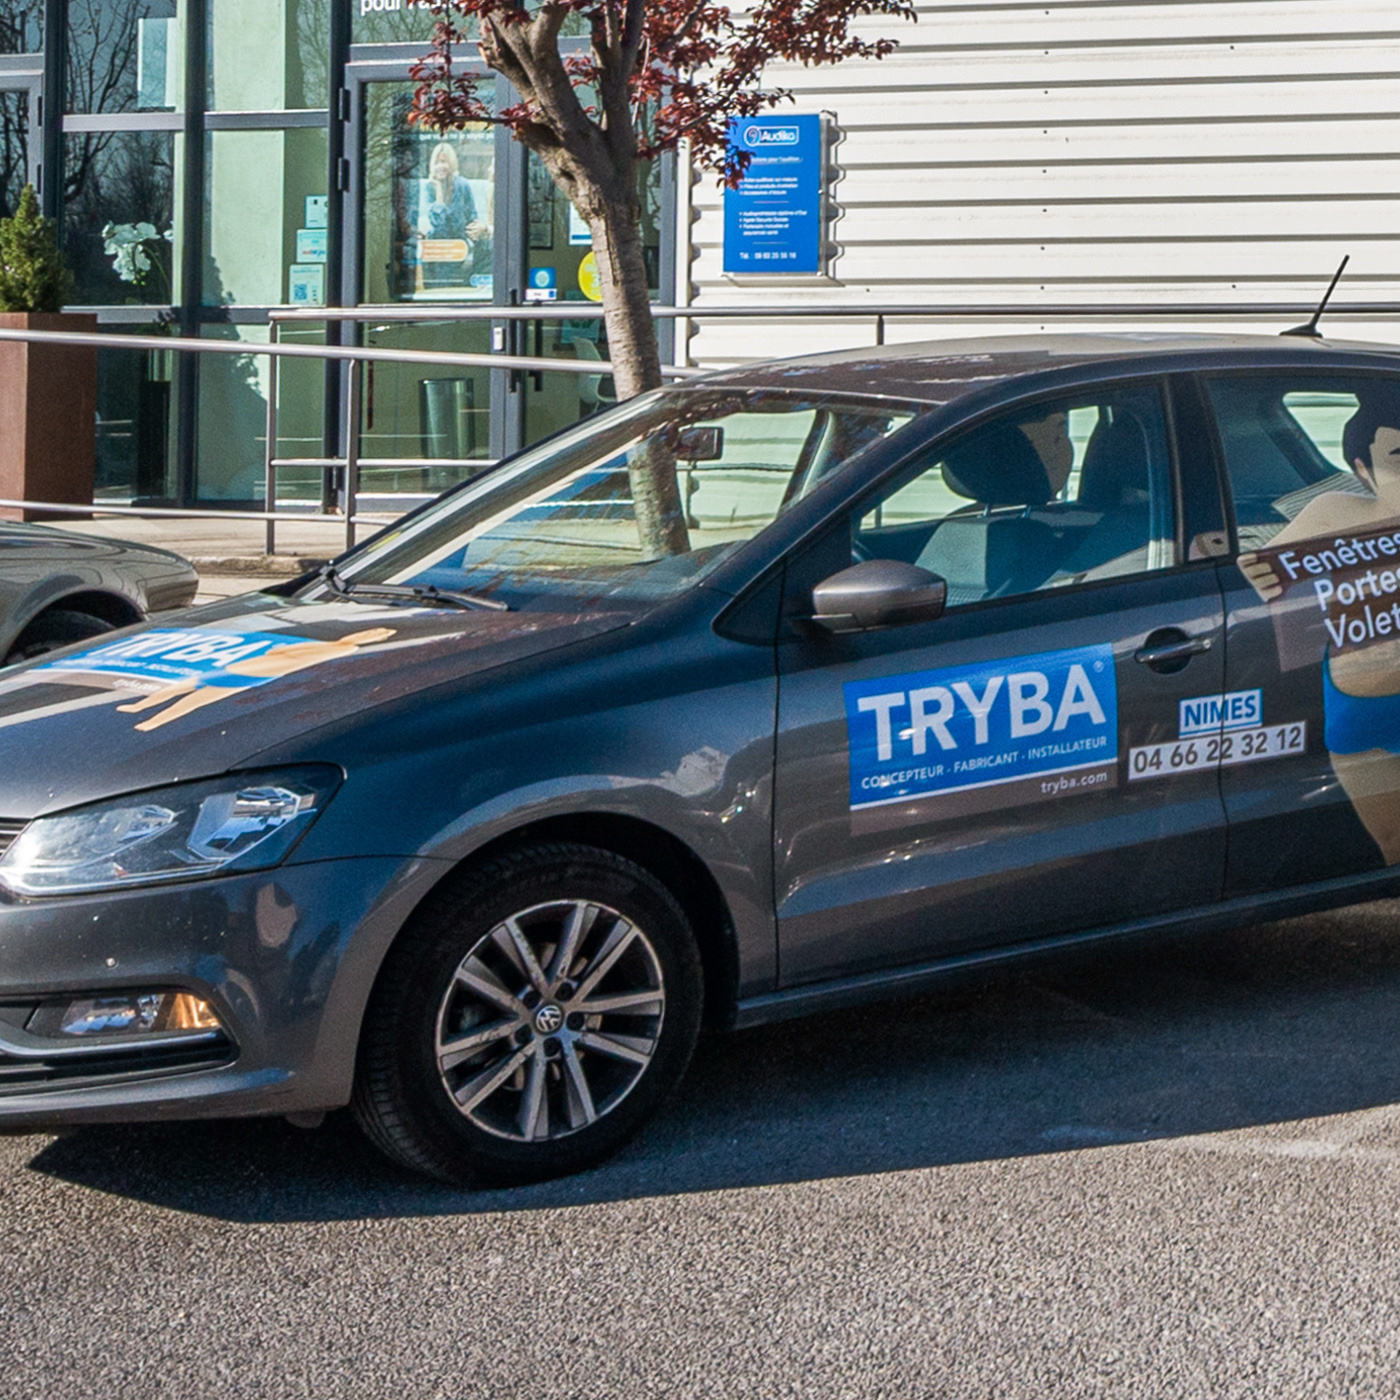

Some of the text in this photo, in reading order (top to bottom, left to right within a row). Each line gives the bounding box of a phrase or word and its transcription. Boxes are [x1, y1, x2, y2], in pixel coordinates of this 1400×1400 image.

[88, 632, 272, 667] TRYBA
[858, 664, 1106, 762] TRYBA
[1183, 694, 1257, 727] NIMES
[861, 736, 1107, 790] CONCEPTEUR FABRICANT INSTALLATEUR
[1133, 726, 1302, 774] 04 66 22 32 12
[1040, 770, 1108, 794] tryba.com
